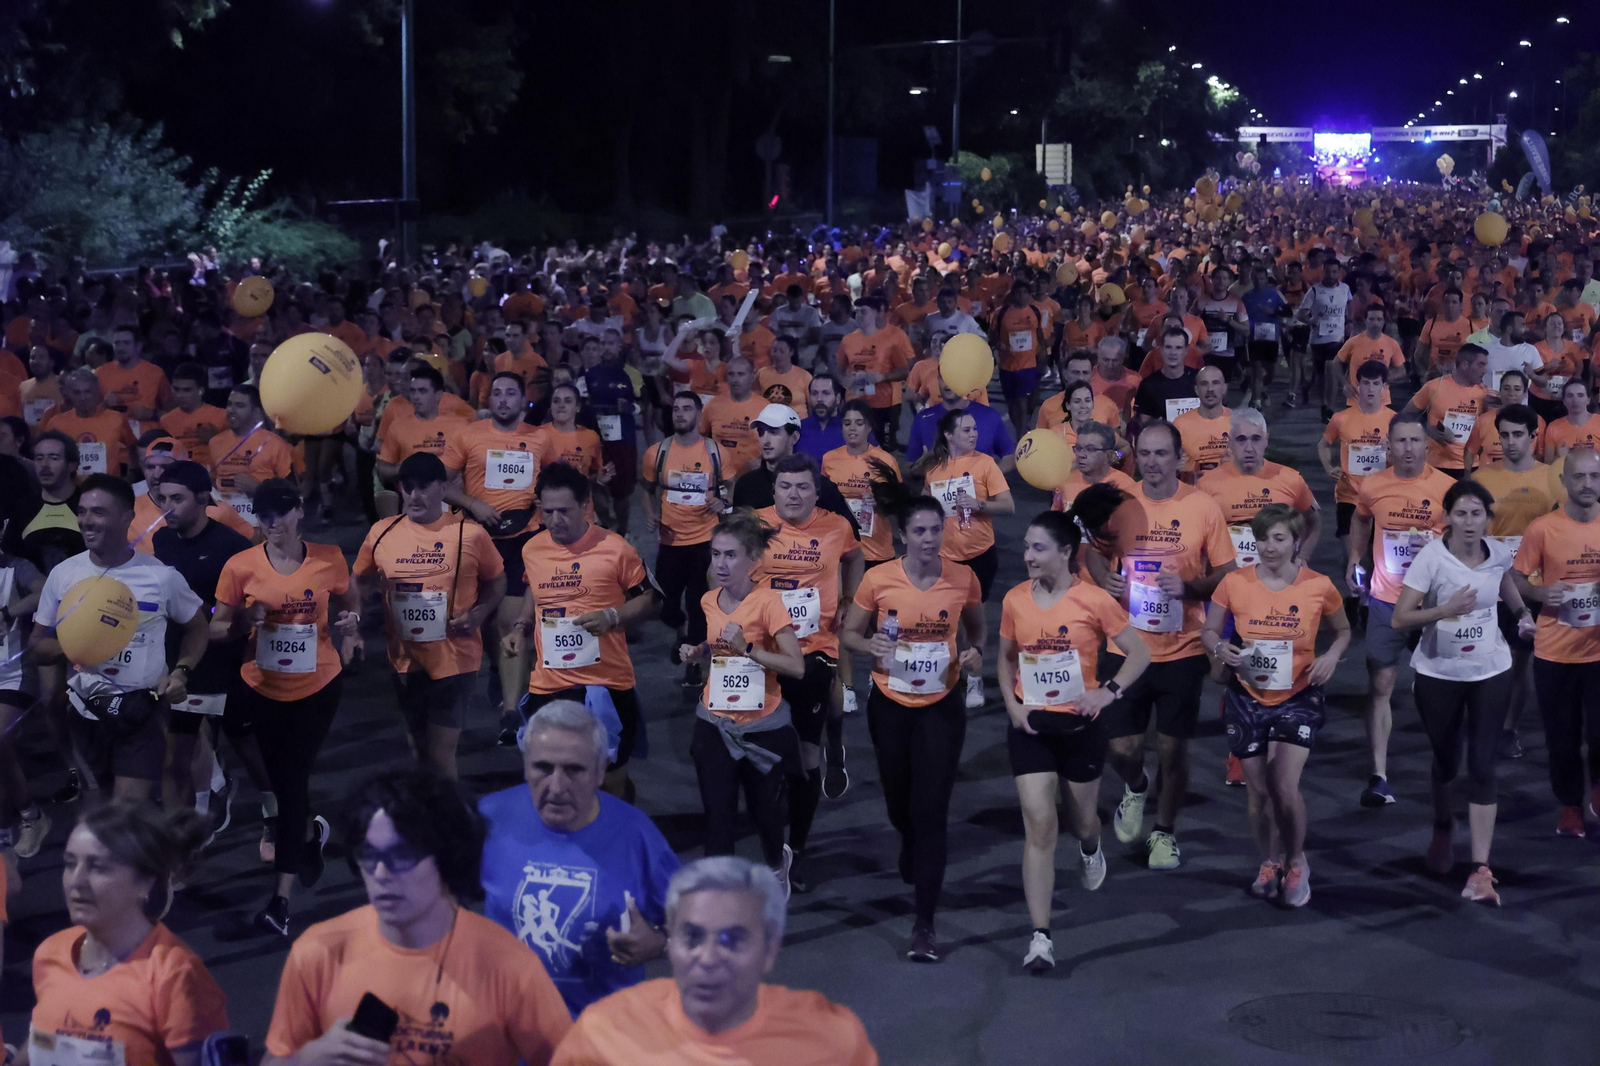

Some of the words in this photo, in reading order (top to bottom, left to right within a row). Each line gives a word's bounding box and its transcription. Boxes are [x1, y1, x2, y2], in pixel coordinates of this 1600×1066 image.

[1452, 422, 1471, 432] 11794
[1356, 455, 1380, 464] 20425
[497, 463, 525, 474] 18604
[1388, 511, 1415, 519] SEVILLA
[1402, 507, 1432, 515] NOCTURNA
[1135, 534, 1163, 542] SEVILLA
[1150, 529, 1181, 538] NOCTURNA
[773, 553, 804, 562] SEVILLA
[788, 549, 821, 557] NOCTURNA
[538, 581, 565, 589] SEVILLA
[1142, 600, 1169, 614] 3683
[1571, 596, 1598, 609] 6656
[402, 608, 436, 621] 18263
[1249, 619, 1280, 627] SEVILLA
[1455, 626, 1483, 639] 4409
[555, 634, 583, 647] 5630
[270, 640, 306, 653] 18264
[903, 659, 938, 673] 14791
[1250, 655, 1277, 669] 3682
[722, 675, 749, 688] 5629
[1033, 670, 1070, 684] 14750
